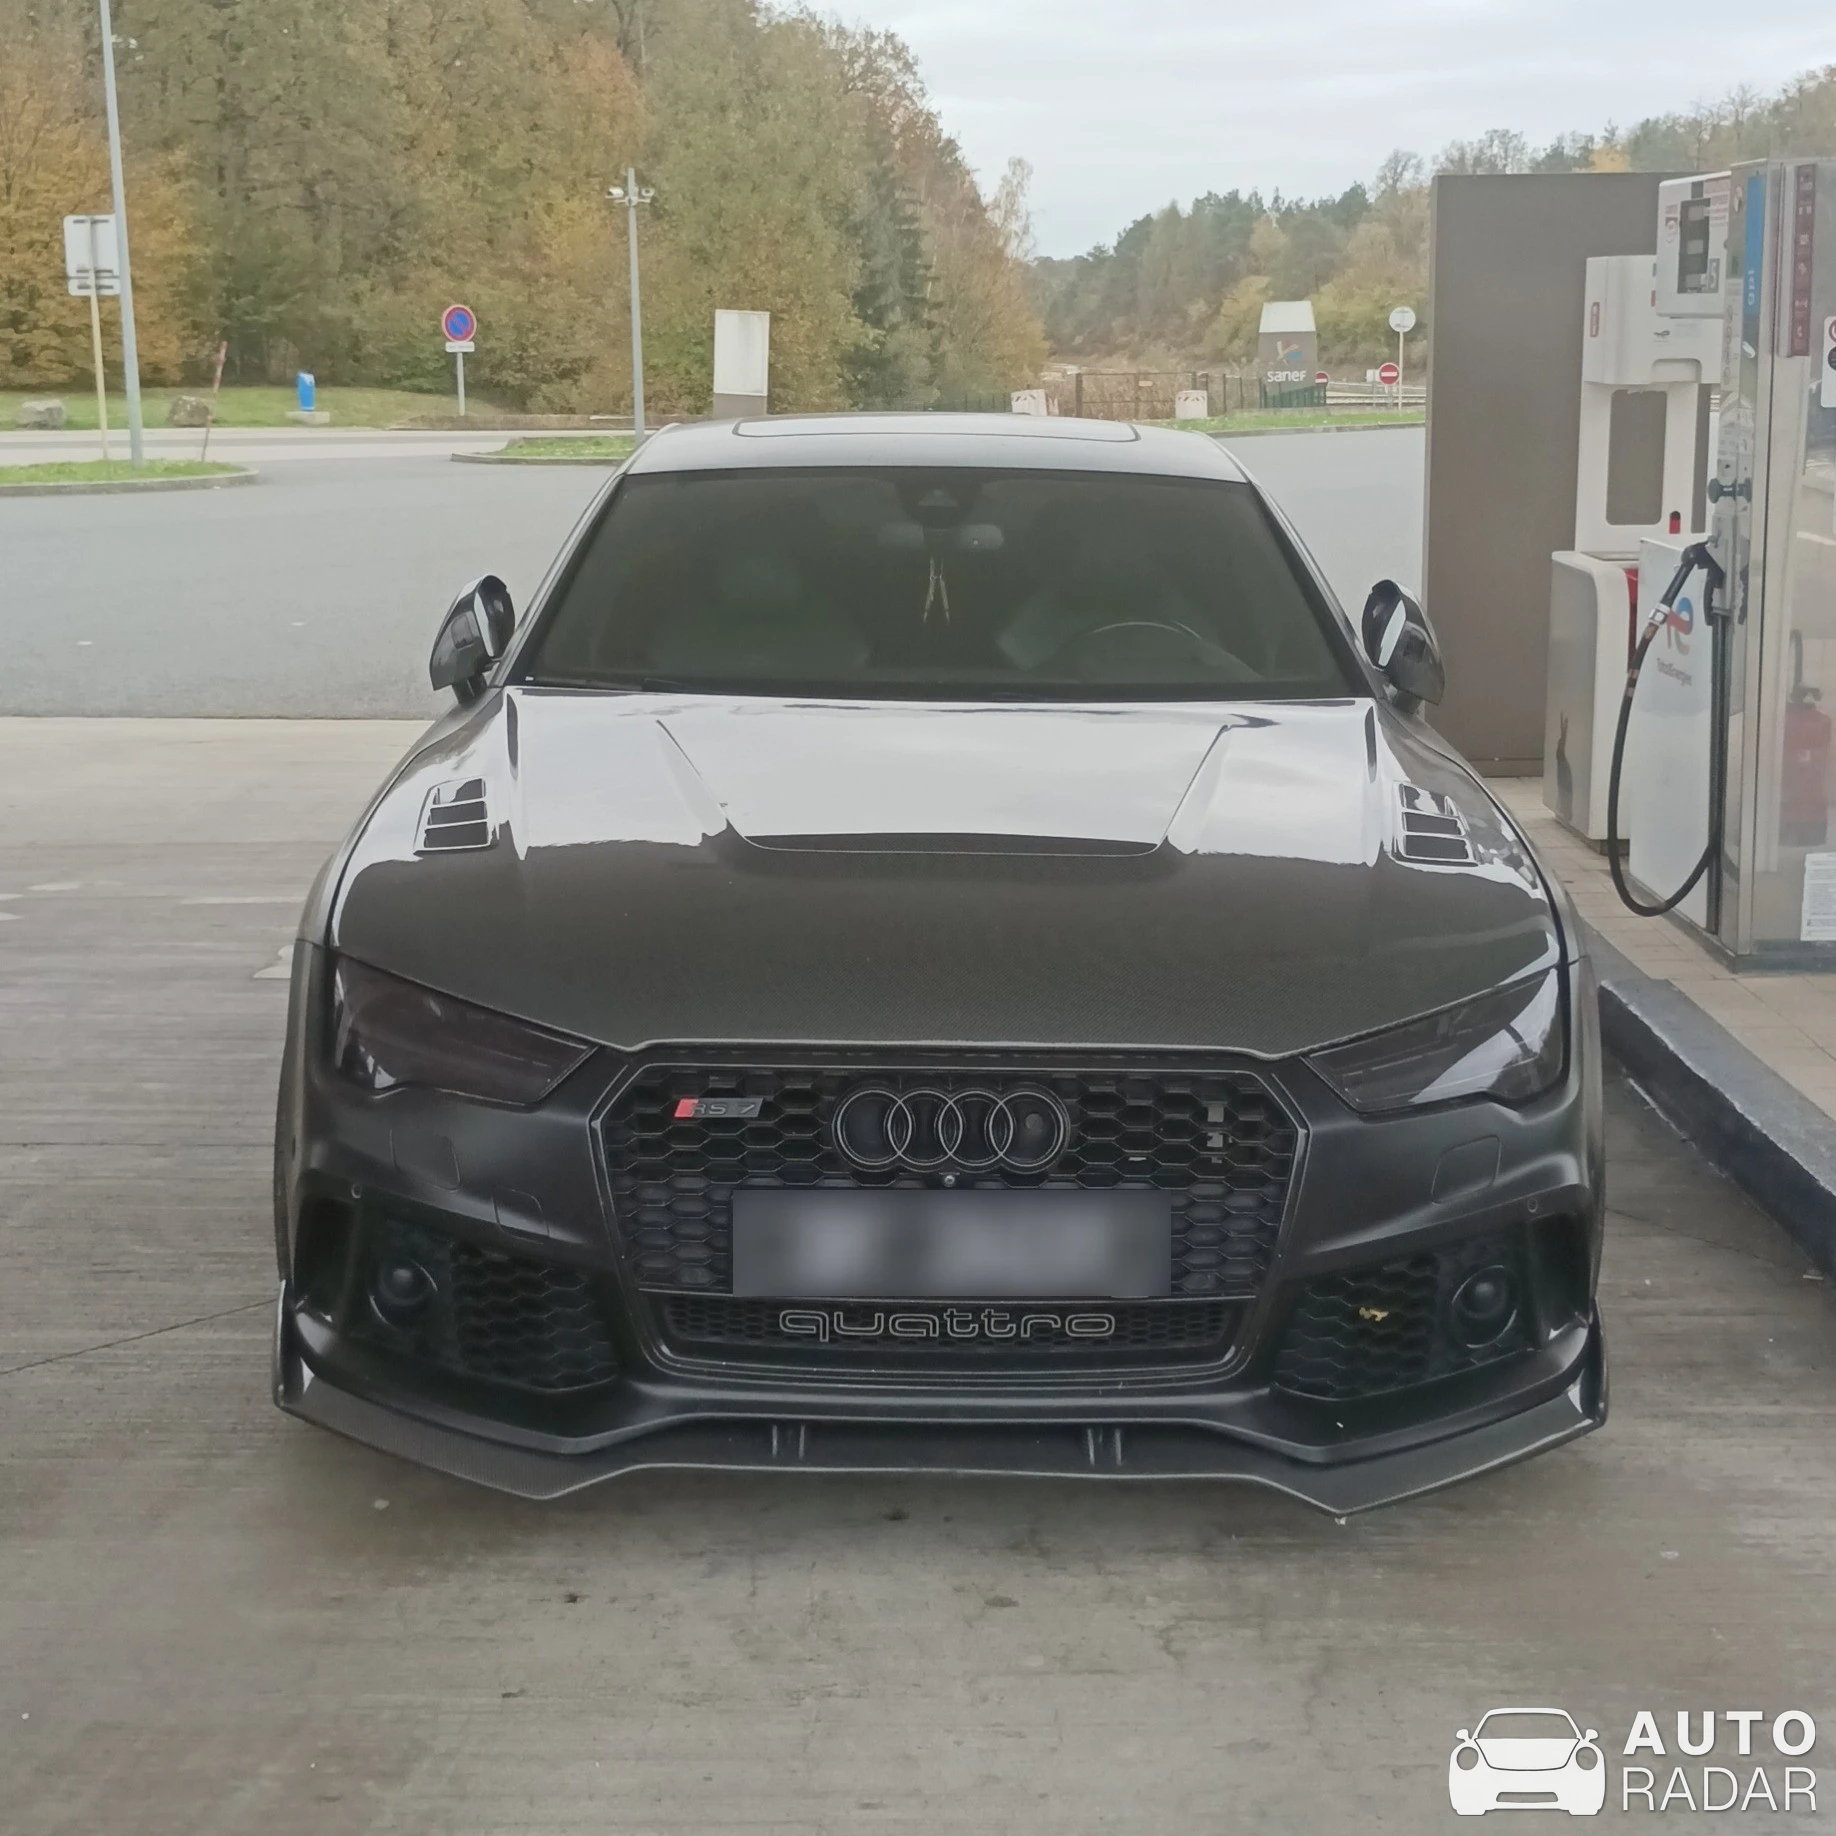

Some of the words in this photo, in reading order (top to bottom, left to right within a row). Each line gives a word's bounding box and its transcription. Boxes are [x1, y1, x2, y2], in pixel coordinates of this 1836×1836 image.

[1267, 370, 1306, 382] sanef
[691, 1103, 728, 1115] RS
[739, 1103, 755, 1115] 7
[779, 1308, 1116, 1342] quattro
